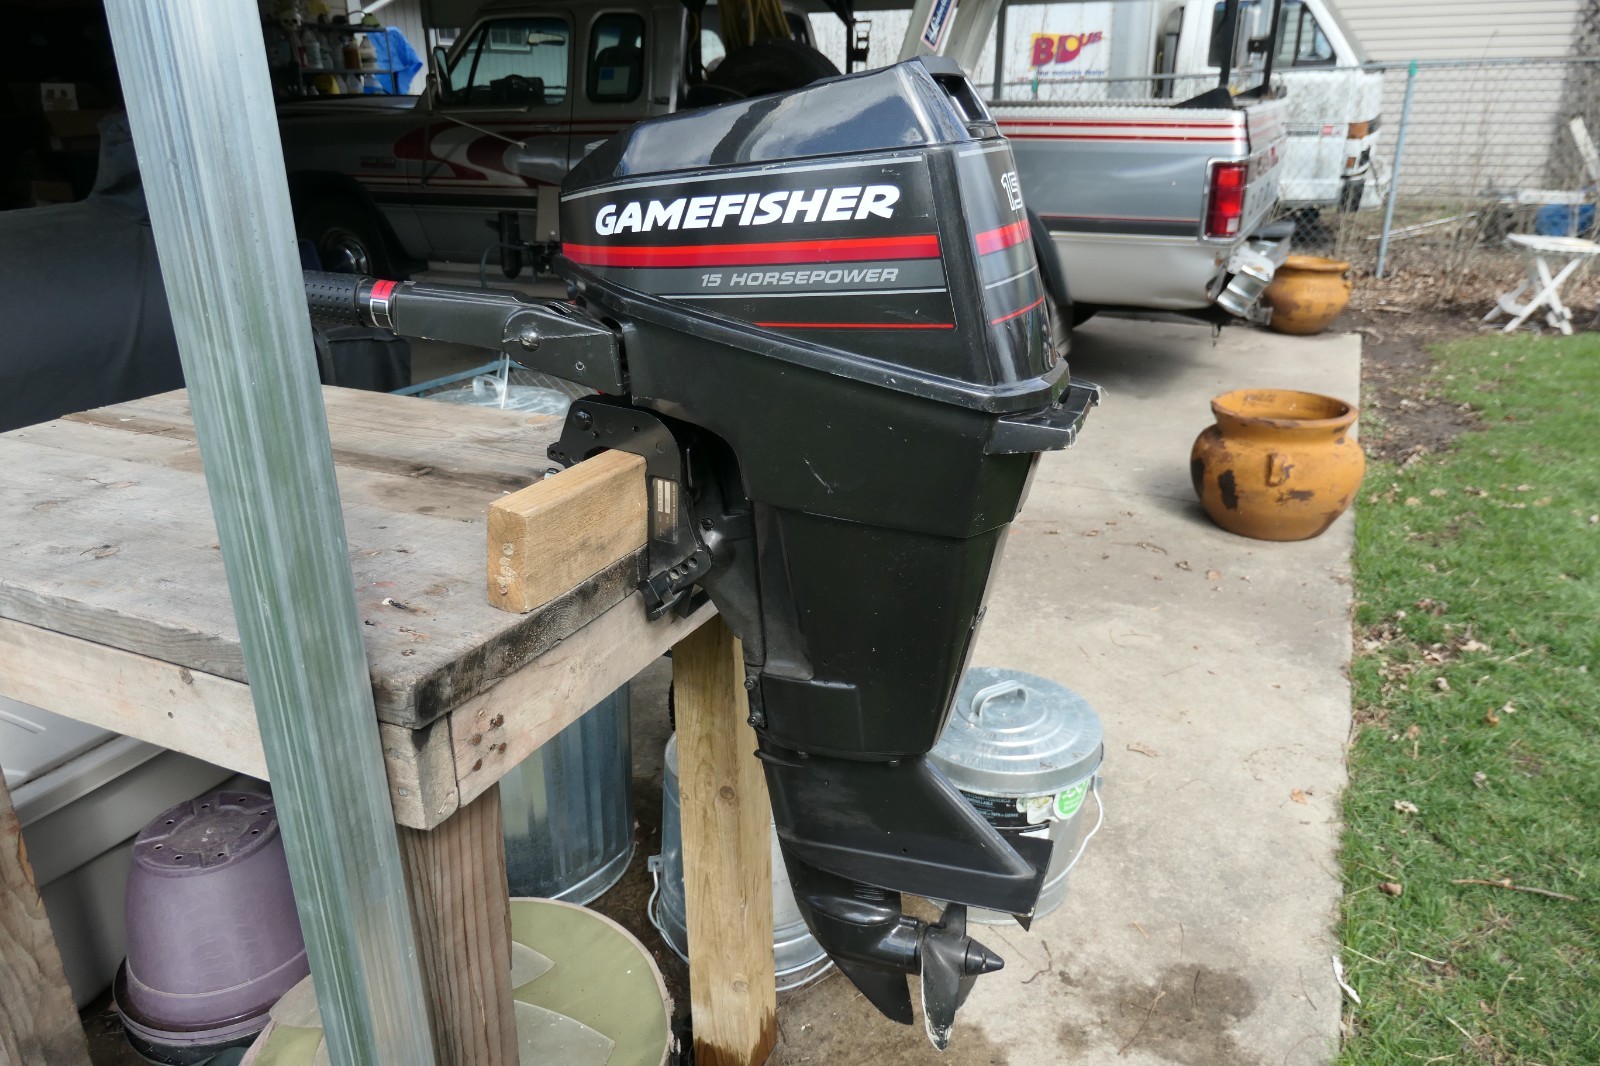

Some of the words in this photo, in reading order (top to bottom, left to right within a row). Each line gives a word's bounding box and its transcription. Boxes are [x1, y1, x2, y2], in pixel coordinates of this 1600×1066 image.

[595, 184, 901, 236] GAMEFISHER
[701, 273, 723, 287] 15
[729, 268, 899, 286] HORSEPOWER
